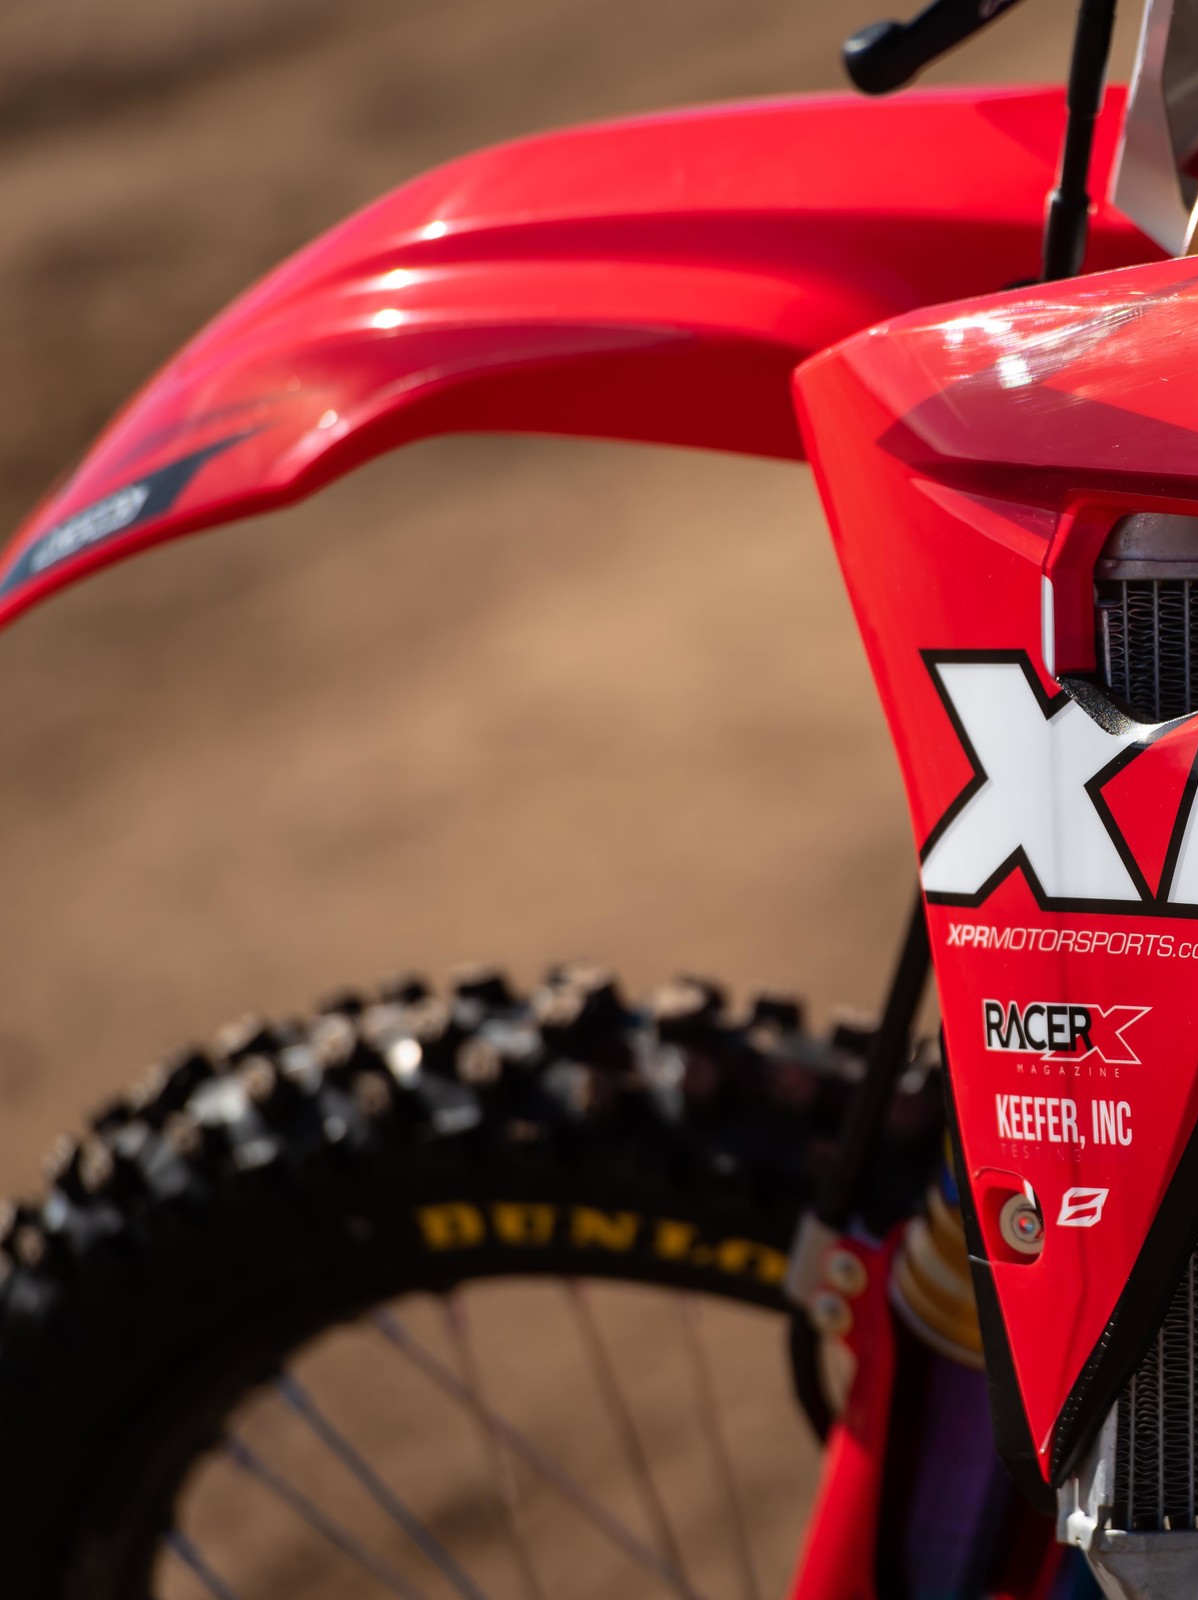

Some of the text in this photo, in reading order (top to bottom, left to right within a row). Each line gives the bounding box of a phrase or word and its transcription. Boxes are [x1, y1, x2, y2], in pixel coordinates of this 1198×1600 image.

[983, 999, 1094, 1052] RACER
[1016, 1063, 1121, 1079] MAGAZINE
[995, 1093, 1132, 1150] KEEFER, INC
[418, 1202, 791, 1284] DUNLO
